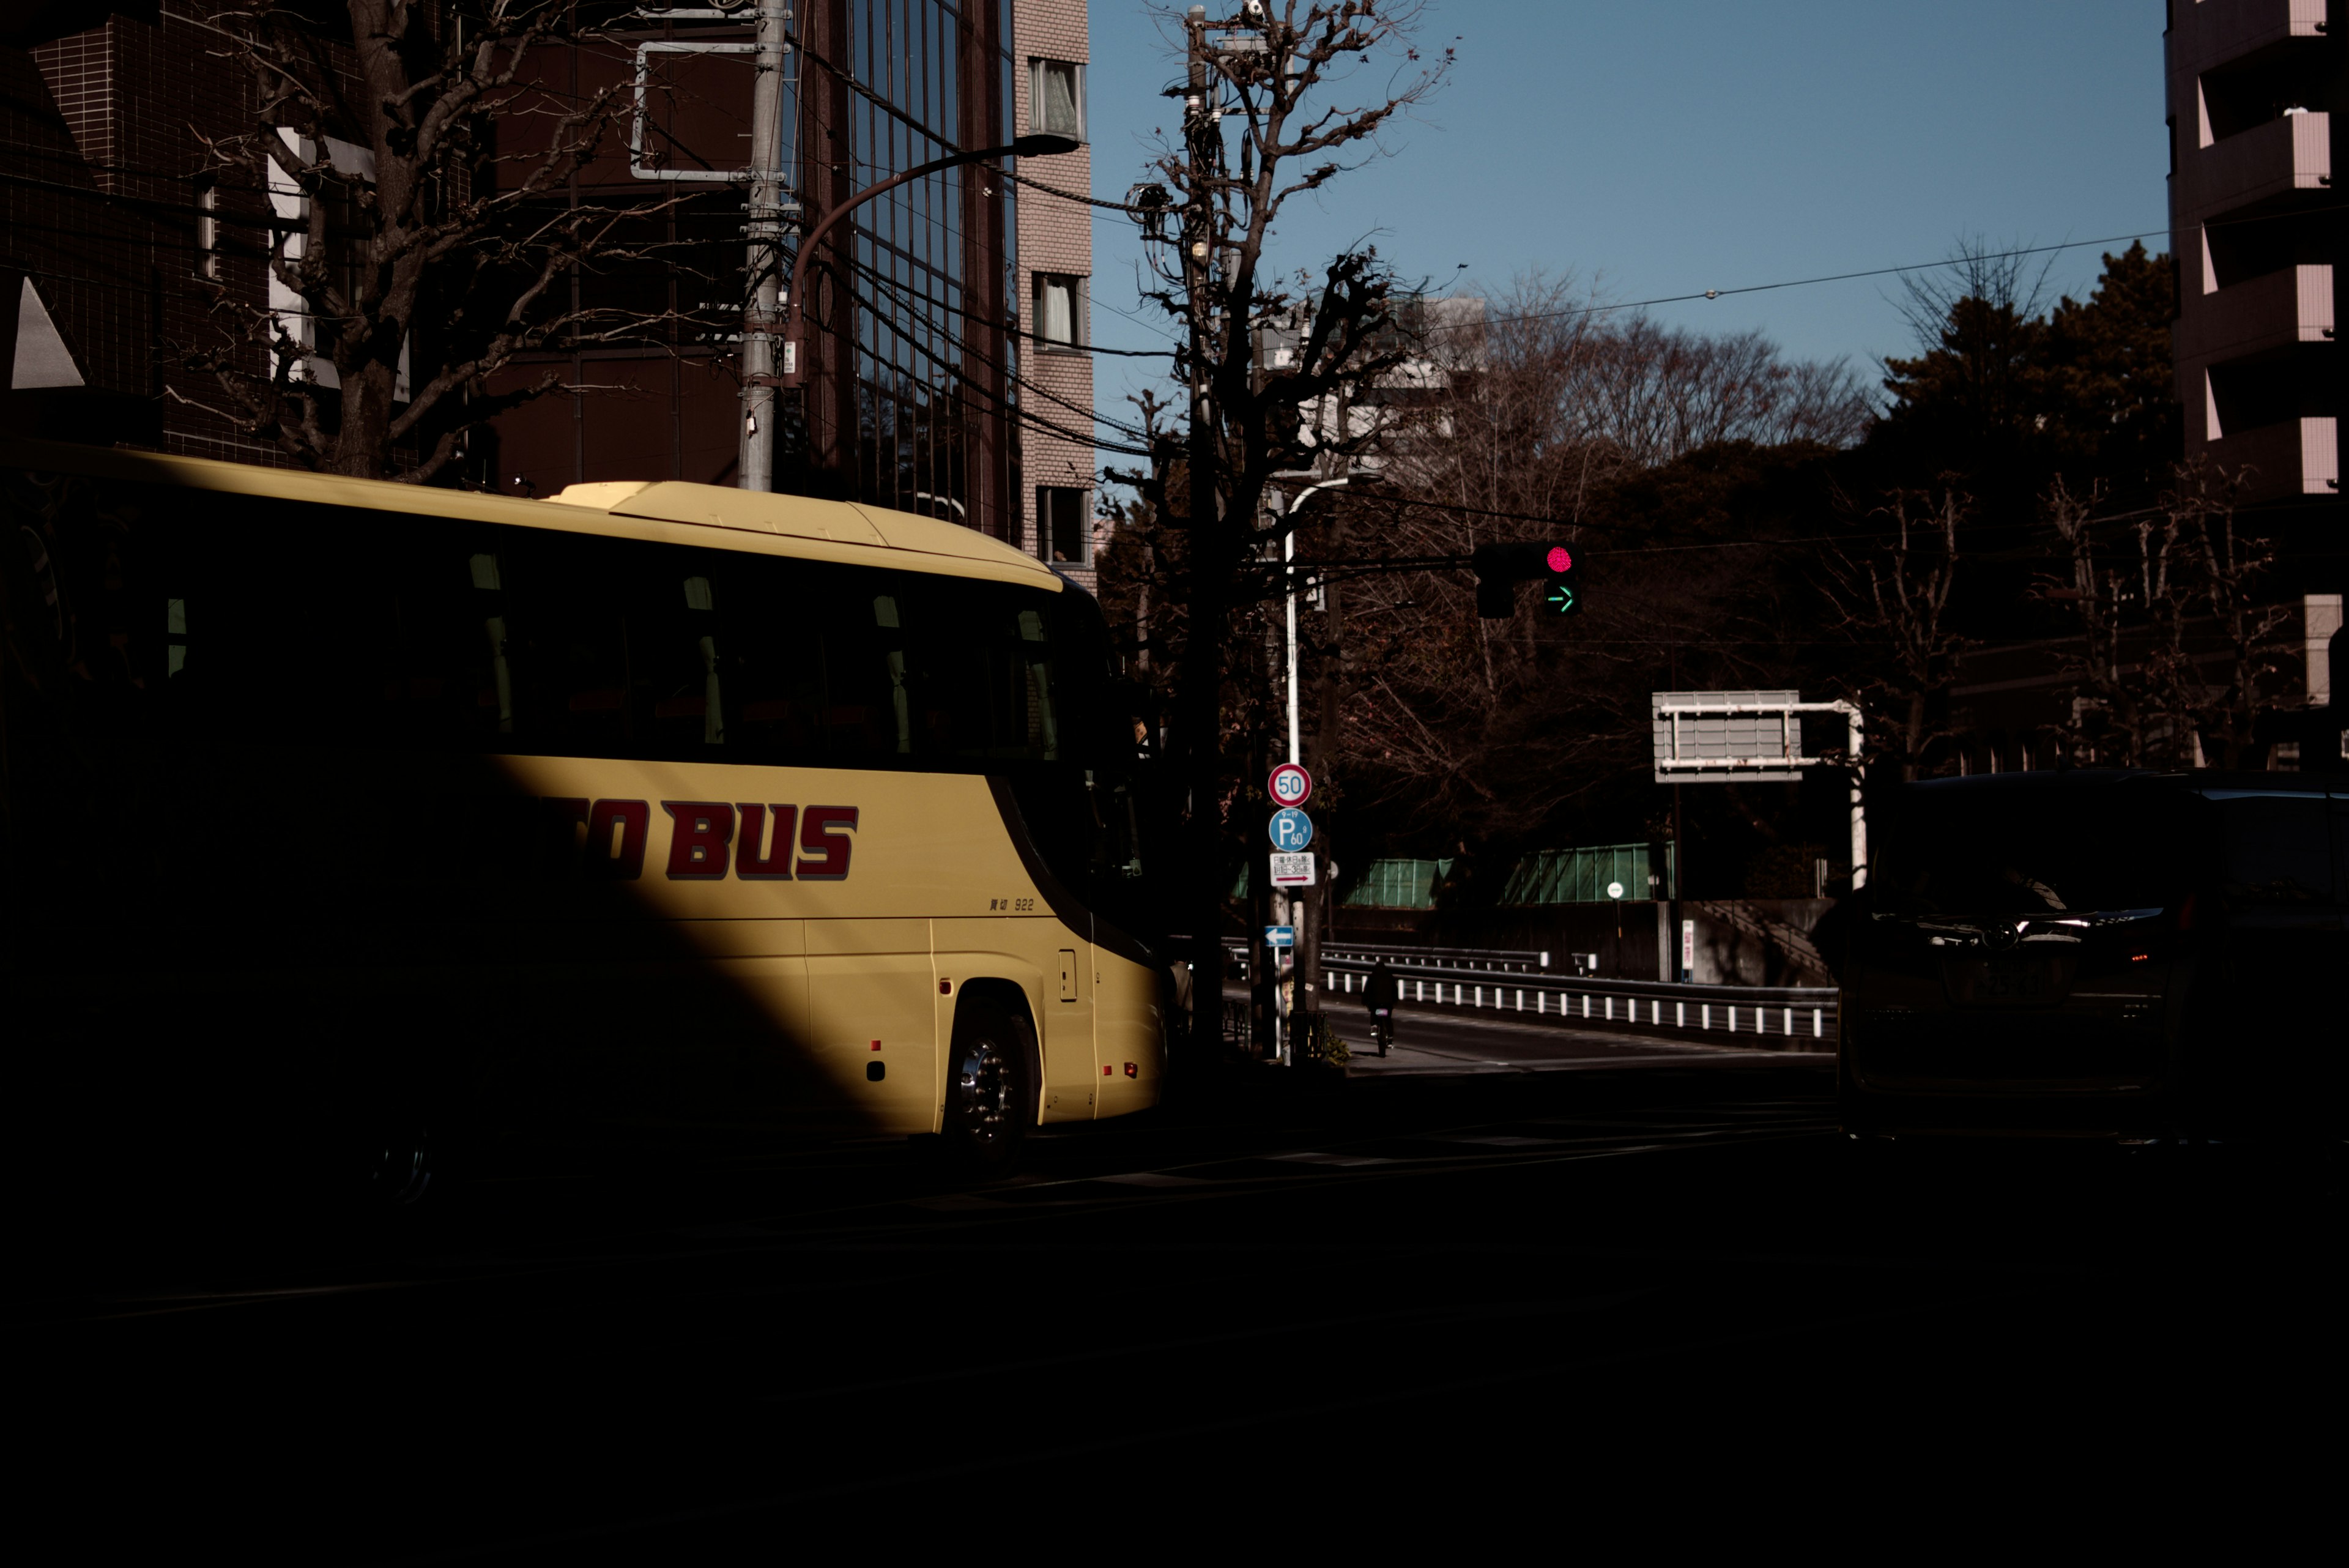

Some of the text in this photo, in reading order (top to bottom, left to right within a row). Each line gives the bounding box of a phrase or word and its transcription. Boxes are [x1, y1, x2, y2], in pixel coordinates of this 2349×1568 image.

[1278, 776, 1301, 795] 50
[660, 800, 859, 881] BUS
[1278, 819, 1296, 845] P
[1015, 898, 1034, 911] 922
